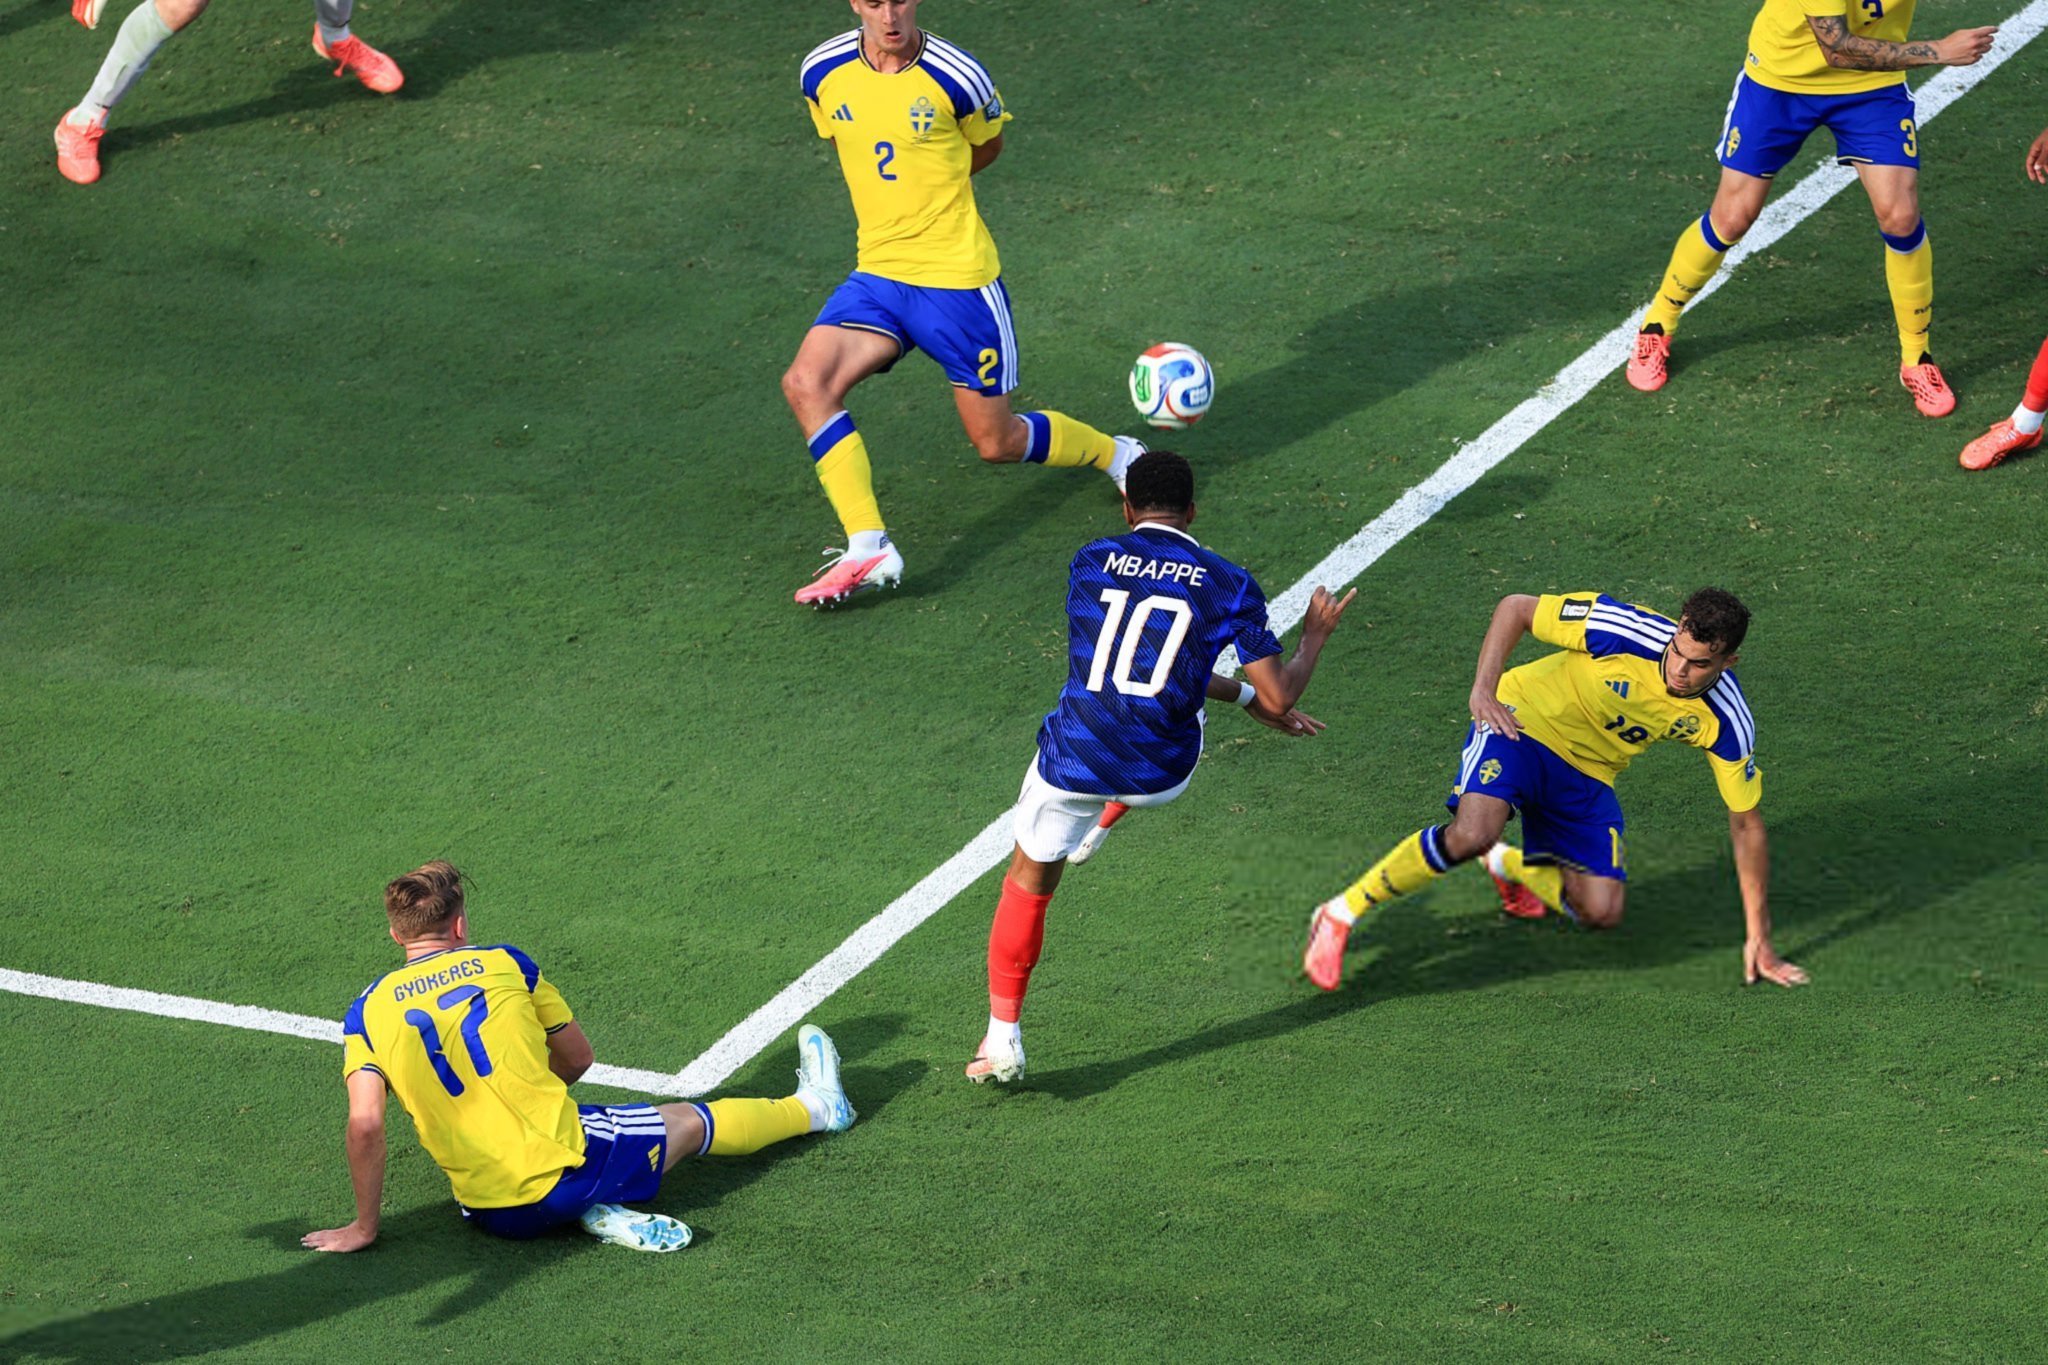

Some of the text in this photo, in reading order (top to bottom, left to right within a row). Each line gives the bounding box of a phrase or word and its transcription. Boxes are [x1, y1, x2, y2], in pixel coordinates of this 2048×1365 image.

[1900, 118, 1917, 158] 3
[874, 141, 897, 181] 2
[977, 347, 998, 387] 2
[1103, 552, 1207, 587] MBAPPE
[1086, 588, 1194, 698] 10
[393, 958, 485, 1002] GYÖKERES
[404, 984, 493, 1097] 17
